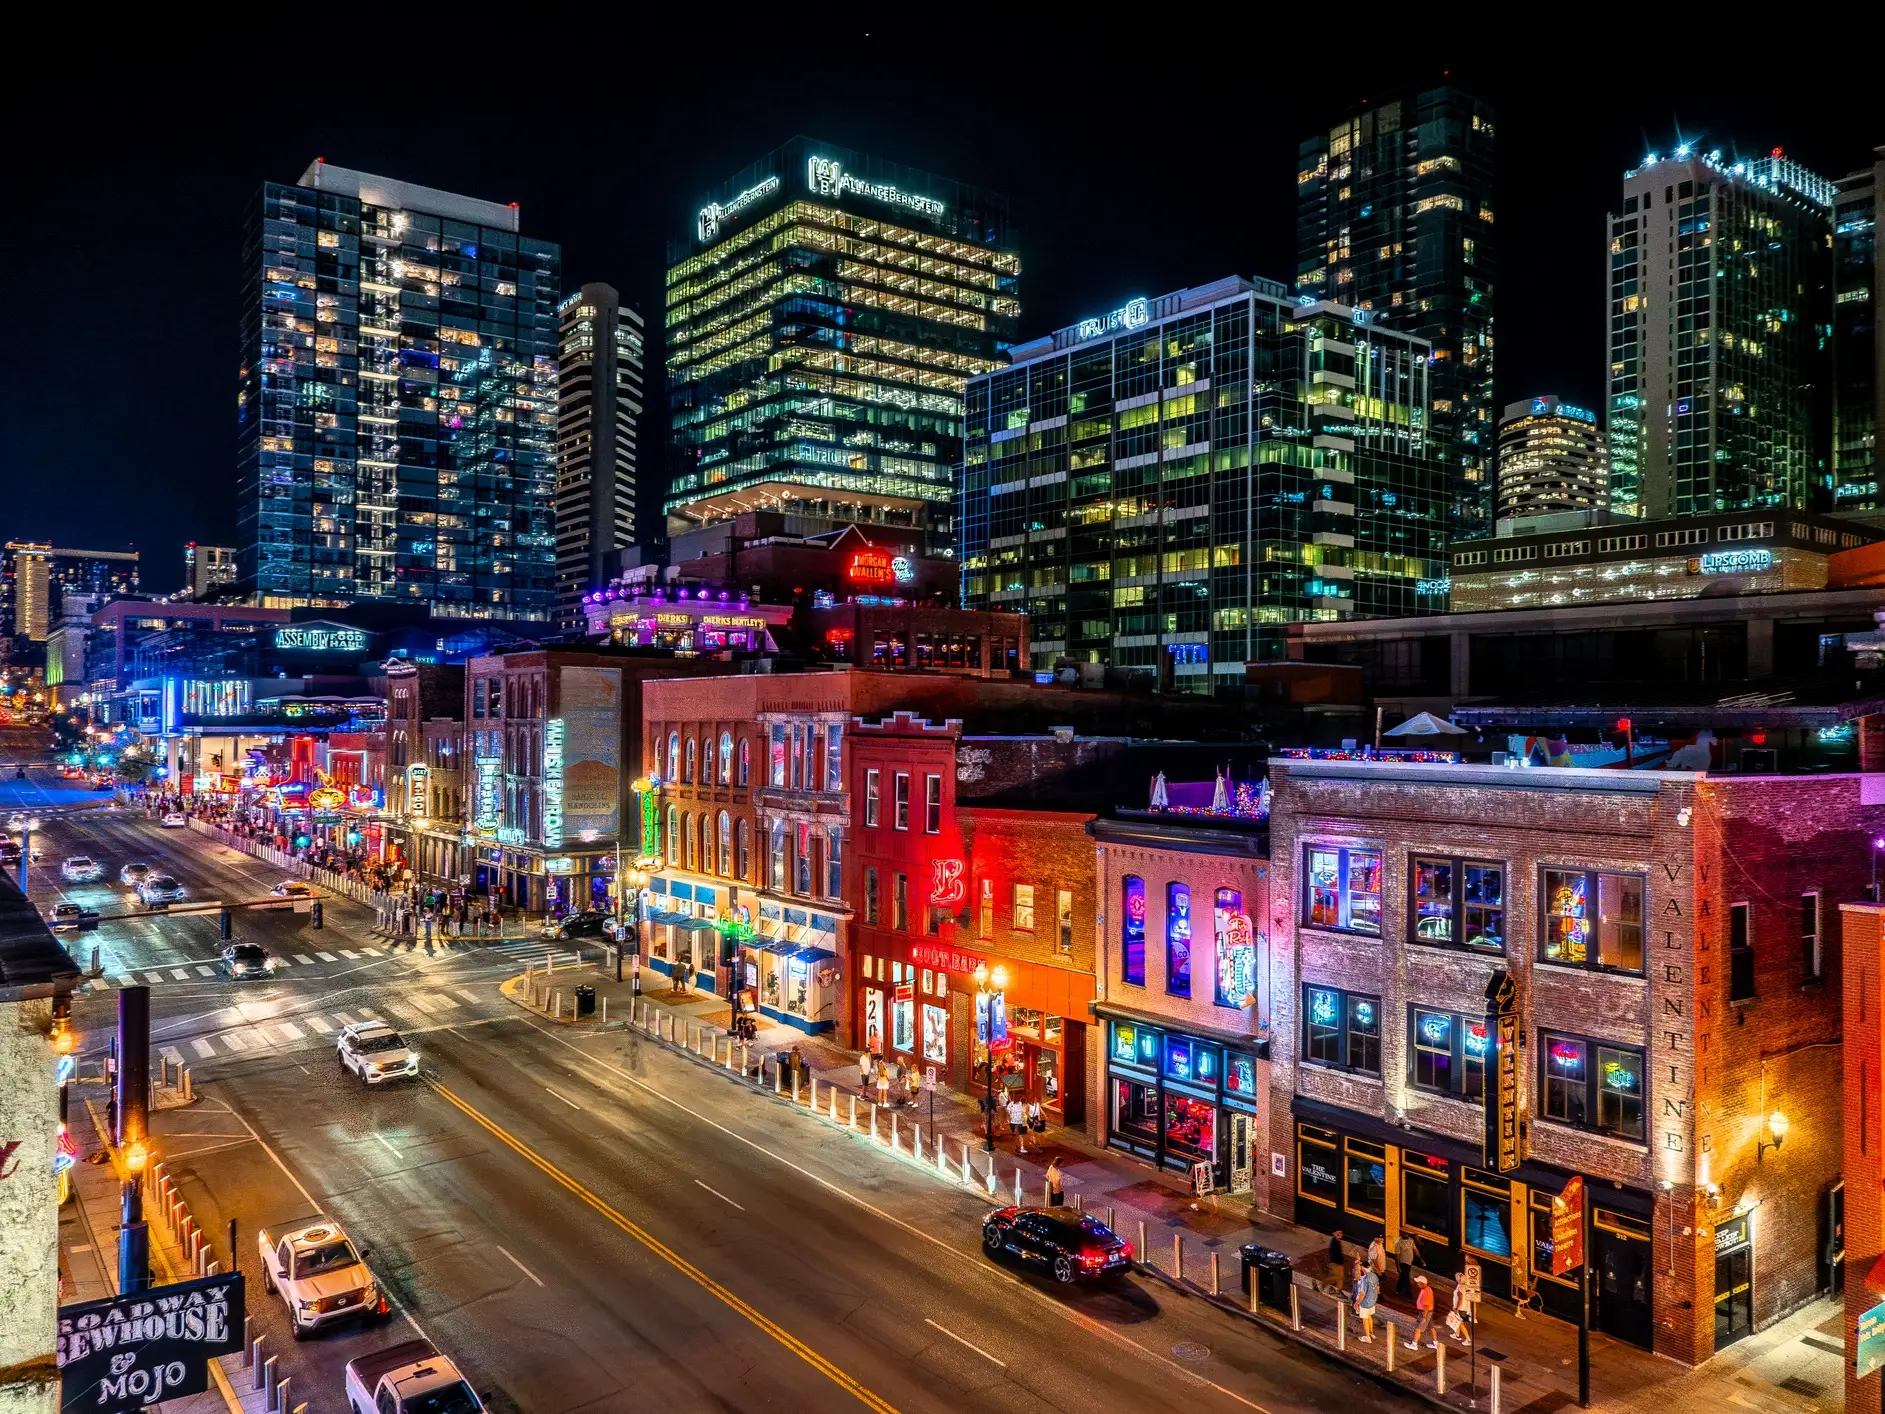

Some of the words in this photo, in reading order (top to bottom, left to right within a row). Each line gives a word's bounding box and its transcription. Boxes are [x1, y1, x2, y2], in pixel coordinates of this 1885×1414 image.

[1081, 308, 1126, 338] TRUIST
[857, 556, 887, 567] MORGAN
[1704, 552, 1769, 567] LIPSCOMB
[852, 566, 892, 579] WALLEN'S
[657, 613, 687, 624] DIERKS
[703, 616, 731, 625] DIERKS
[279, 631, 329, 646] ASSEMBLY
[329, 633, 363, 641] FOOD
[545, 720, 564, 800] WHISKEY
[545, 802, 564, 846] ROW
[1228, 917, 1248, 930] Tin
[1228, 931, 1252, 946] Roof
[915, 946, 949, 967] BOOT
[1663, 863, 1683, 1153] VALENTINE
[1699, 864, 1712, 1153] VALENTINE
[1302, 1165, 1337, 1182] VALENTINE
[1311, 1163, 1325, 1173] THE
[1616, 1233, 1627, 1241] 312
[57, 1285, 230, 1335] ROADWAY
[110, 1352, 136, 1375] &
[98, 1361, 186, 1404] MOJO
